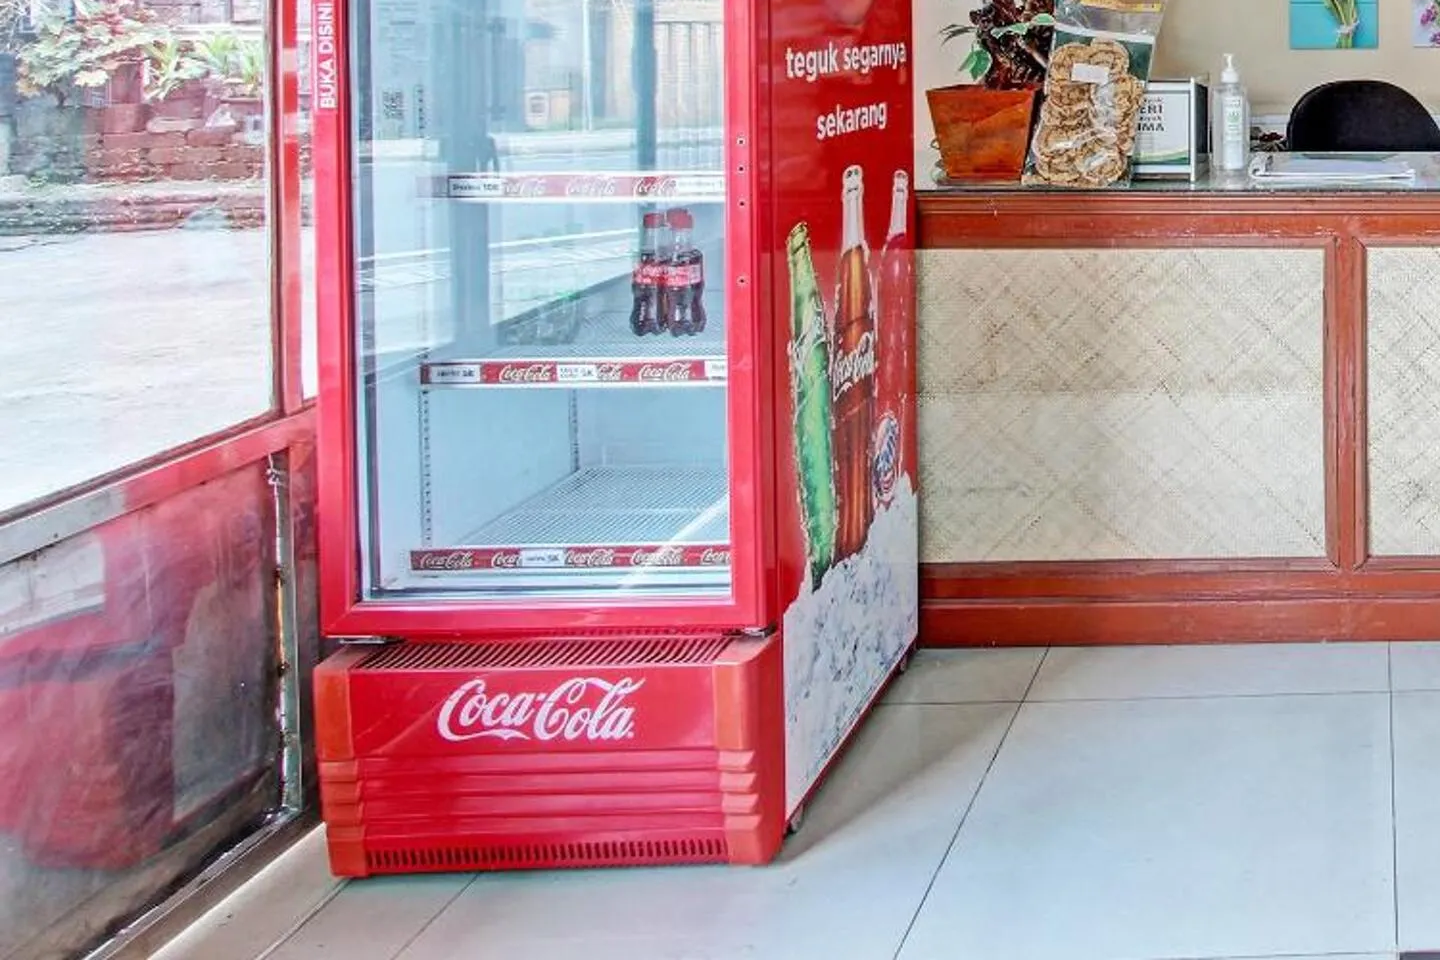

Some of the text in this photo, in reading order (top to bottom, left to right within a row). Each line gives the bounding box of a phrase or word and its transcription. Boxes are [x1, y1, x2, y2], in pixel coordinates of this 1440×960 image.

[786, 41, 906, 82] teguk segarnya
[318, 58, 337, 109] BUKA
[816, 102, 887, 140] sekarang
[499, 363, 555, 381] Coca-Cola
[638, 362, 692, 383] Coca-Cola
[420, 551, 474, 569] Coca-Cola
[437, 677, 646, 741] Coca-Cola
